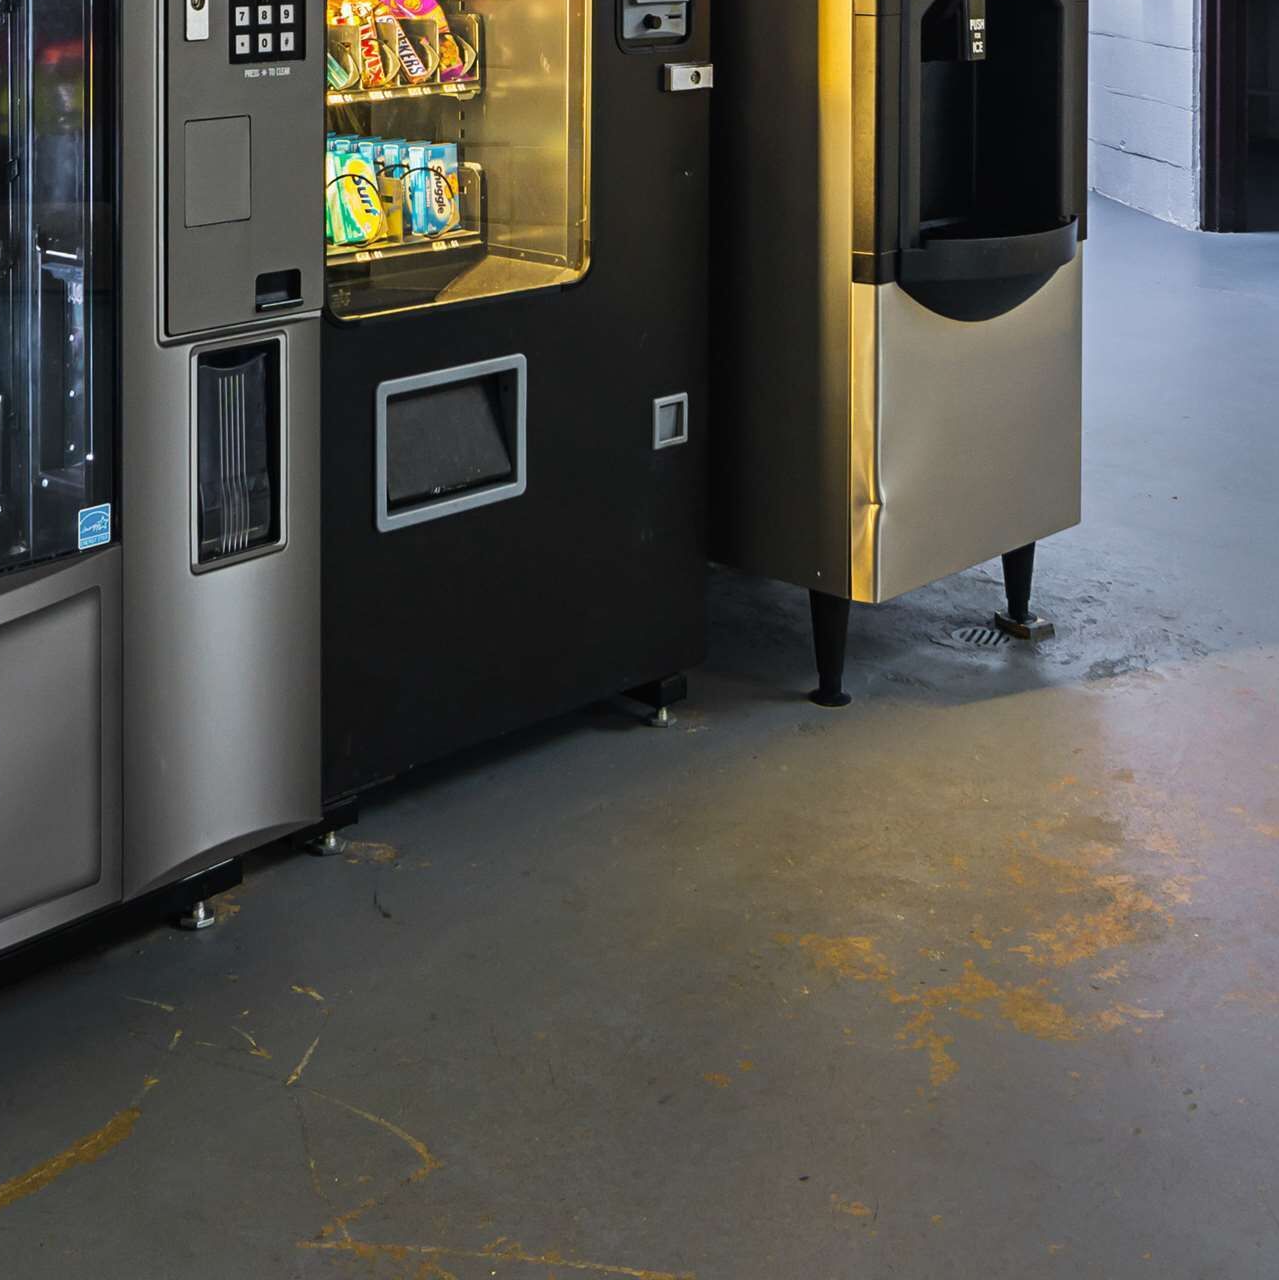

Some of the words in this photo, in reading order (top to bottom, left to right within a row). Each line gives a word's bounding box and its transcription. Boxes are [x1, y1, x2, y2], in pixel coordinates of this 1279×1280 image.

[240, 11, 245, 21] 7
[261, 10, 267, 20] 8
[283, 9, 289, 19] 9
[970, 19, 985, 31] PUSH
[261, 38, 268, 47] 0
[972, 41, 983, 53] ICE
[434, 166, 447, 215] Snuggle
